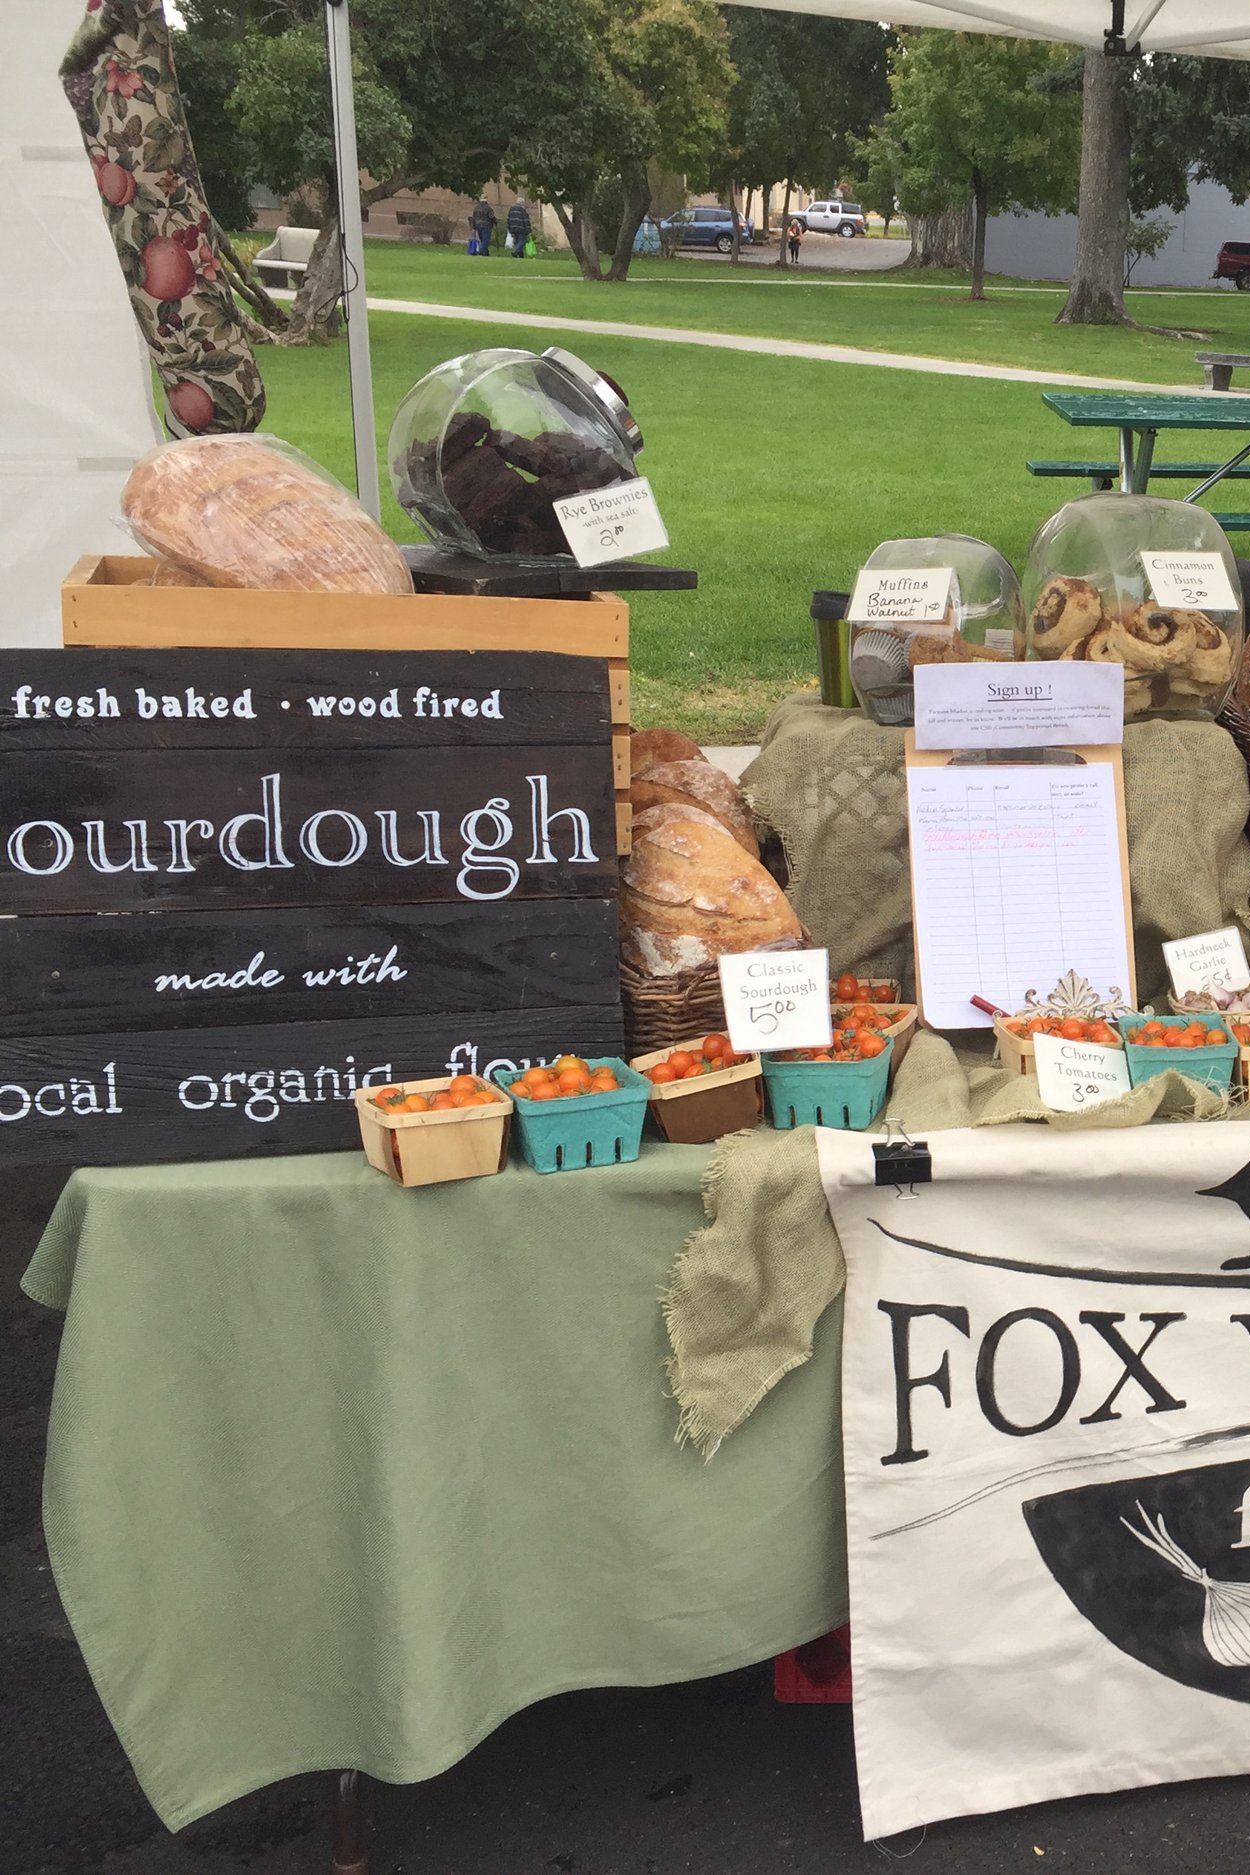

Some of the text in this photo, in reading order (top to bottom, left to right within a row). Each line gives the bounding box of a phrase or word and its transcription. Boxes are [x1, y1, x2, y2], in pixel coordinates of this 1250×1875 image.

[560, 488, 649, 521] Rye Brownies
[1151, 559, 1215, 570] Cinnamon
[878, 578, 929, 591] Muffins
[1173, 574, 1203, 585] Buns
[867, 593, 923, 608] Banana
[867, 607, 916, 618] Walnut
[987, 683, 1020, 699] Sign
[1024, 685, 1043, 699] up
[11, 684, 505, 719] fresh baked wood fired
[6, 772, 600, 901] ourdough
[1175, 938, 1232, 961] Hardneck
[154, 945, 409, 993] made with
[747, 960, 804, 978] Classic
[1189, 956, 1227, 972] Garlic
[740, 978, 817, 1000] Sourdough
[1060, 1045, 1106, 1065] Cherry
[1053, 1061, 1118, 1081] Tomatoes
[0, 1042, 576, 1123] ocal organic flo
[877, 1298, 1187, 1467] FOX
